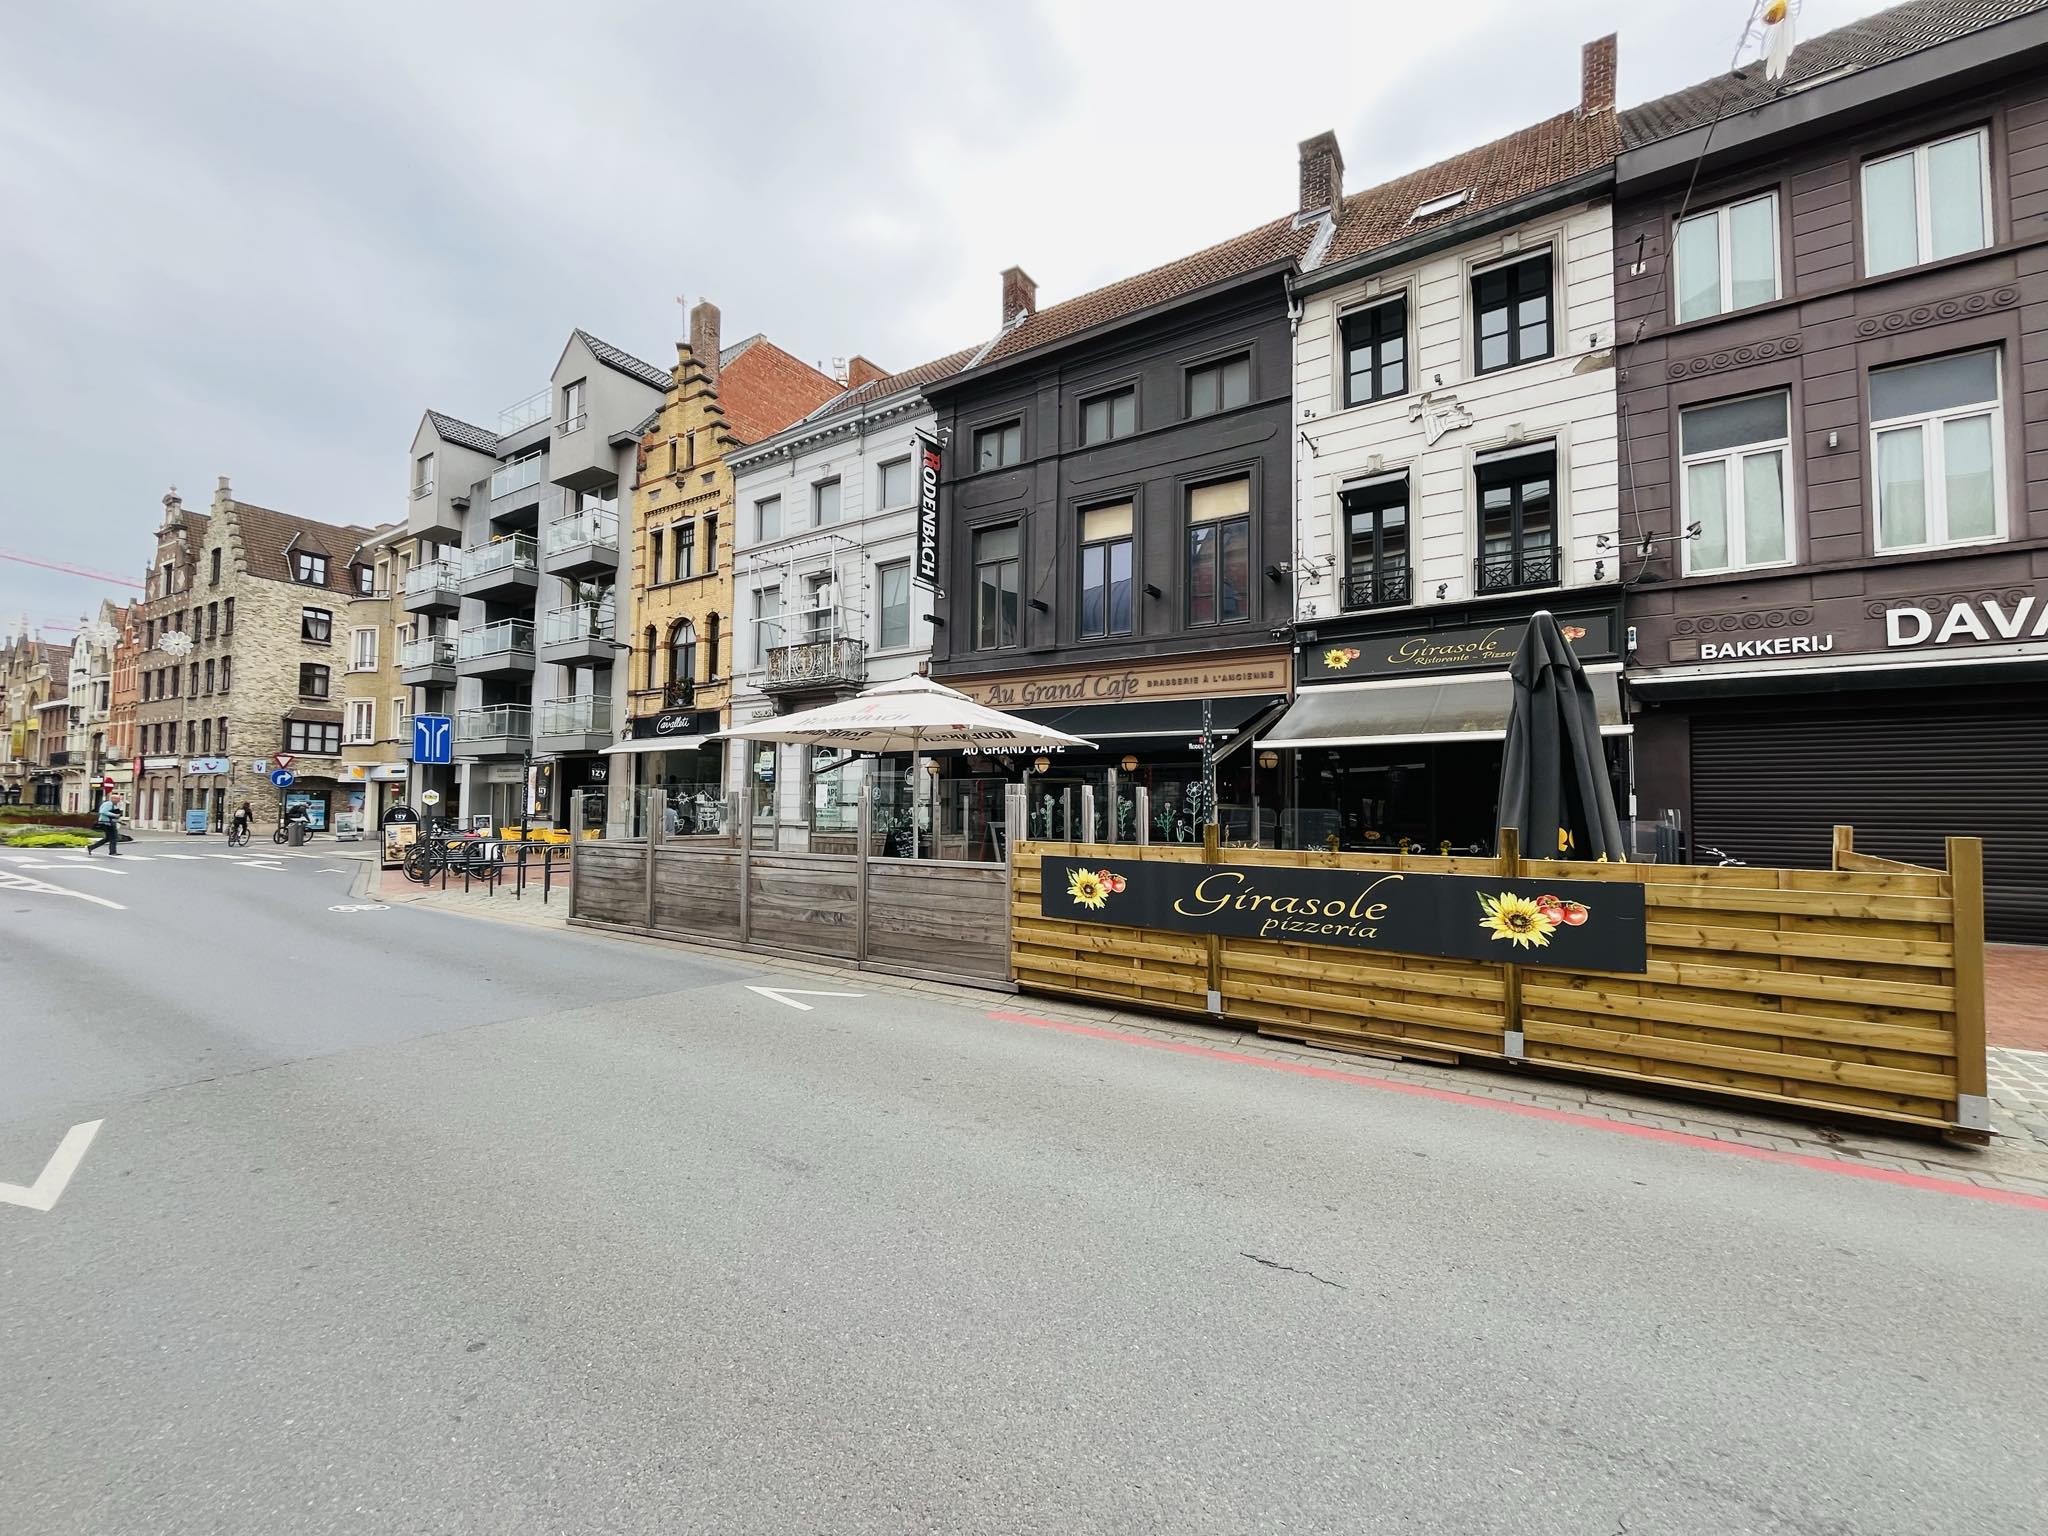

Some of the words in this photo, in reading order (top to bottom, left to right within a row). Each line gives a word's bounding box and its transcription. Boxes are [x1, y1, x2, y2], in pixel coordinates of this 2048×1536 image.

[922, 448, 941, 578] RODENBACH
[1387, 627, 1505, 664] Girasole
[1413, 654, 1470, 666] Ristorante
[1482, 649, 1518, 660] Pizzer
[1700, 633, 1833, 660] BAKKERIJ
[983, 684, 1015, 705] Au
[1021, 674, 1091, 706] Grand
[1147, 676, 1199, 688] BRASSERIE
[1213, 670, 1275, 683] L'ANCIENNE
[656, 715, 690, 735] Cavalleti
[962, 747, 979, 756] AU
[982, 746, 1027, 755] GRAND
[1173, 872, 1404, 920] Girasole
[1259, 916, 1378, 939] pizzeria
